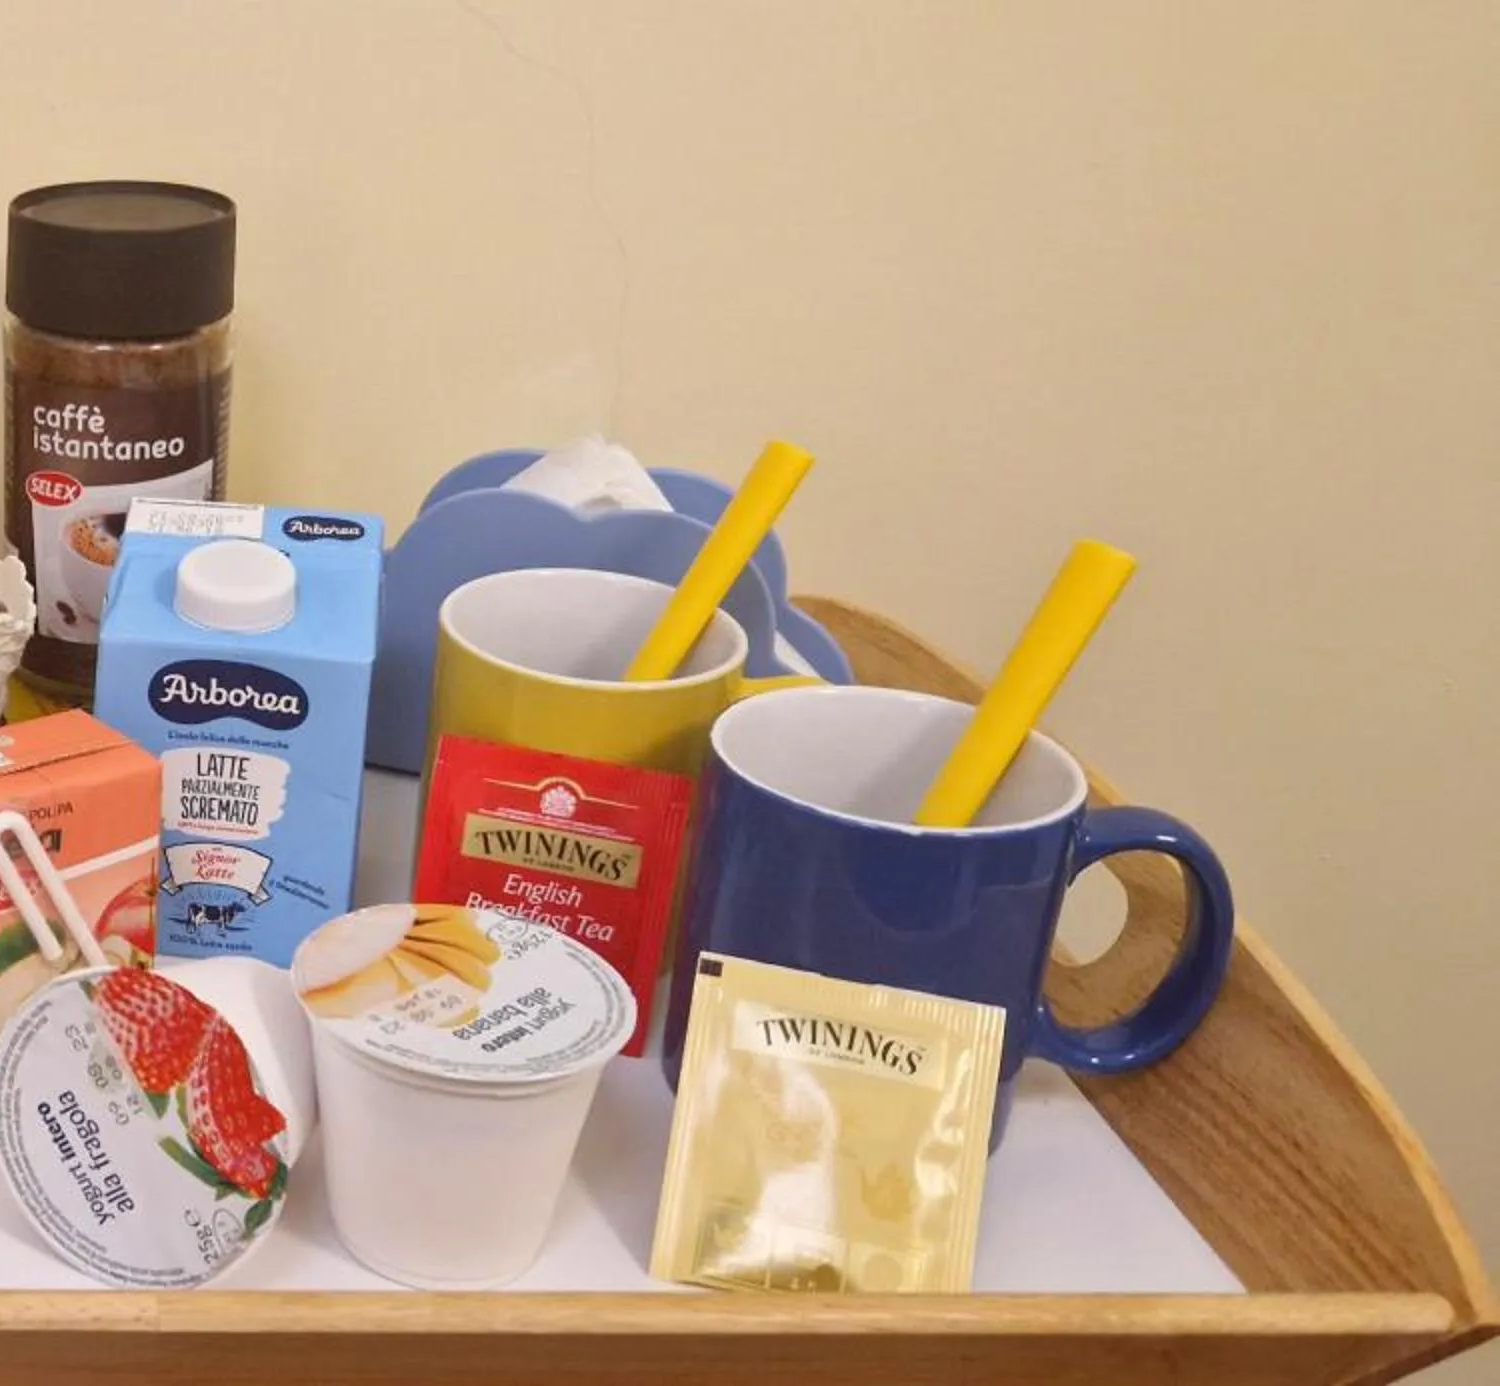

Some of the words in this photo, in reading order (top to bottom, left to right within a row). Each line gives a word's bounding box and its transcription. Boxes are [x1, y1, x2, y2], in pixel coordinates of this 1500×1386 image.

[34, 404, 105, 435] caffè
[33, 428, 185, 461] istantaneo
[29, 477, 79, 501] SELEX
[288, 520, 362, 537] Arborea
[160, 673, 301, 715] Arborea
[197, 752, 250, 781] LATTE
[181, 778, 261, 801] PARZIALMENTE
[180, 796, 259, 826] SCREMATO
[474, 829, 628, 882] TWININGS
[503, 873, 583, 909] English
[575, 914, 615, 943] Tea
[451, 1004, 528, 1040] banana
[481, 1026, 534, 1053] intero
[756, 1017, 923, 1075] TWININGS
[36, 1101, 76, 1161] intero
[57, 1088, 104, 1171] fragola
[68, 1159, 116, 1225] yogurt
[102, 1170, 136, 1213] alla
